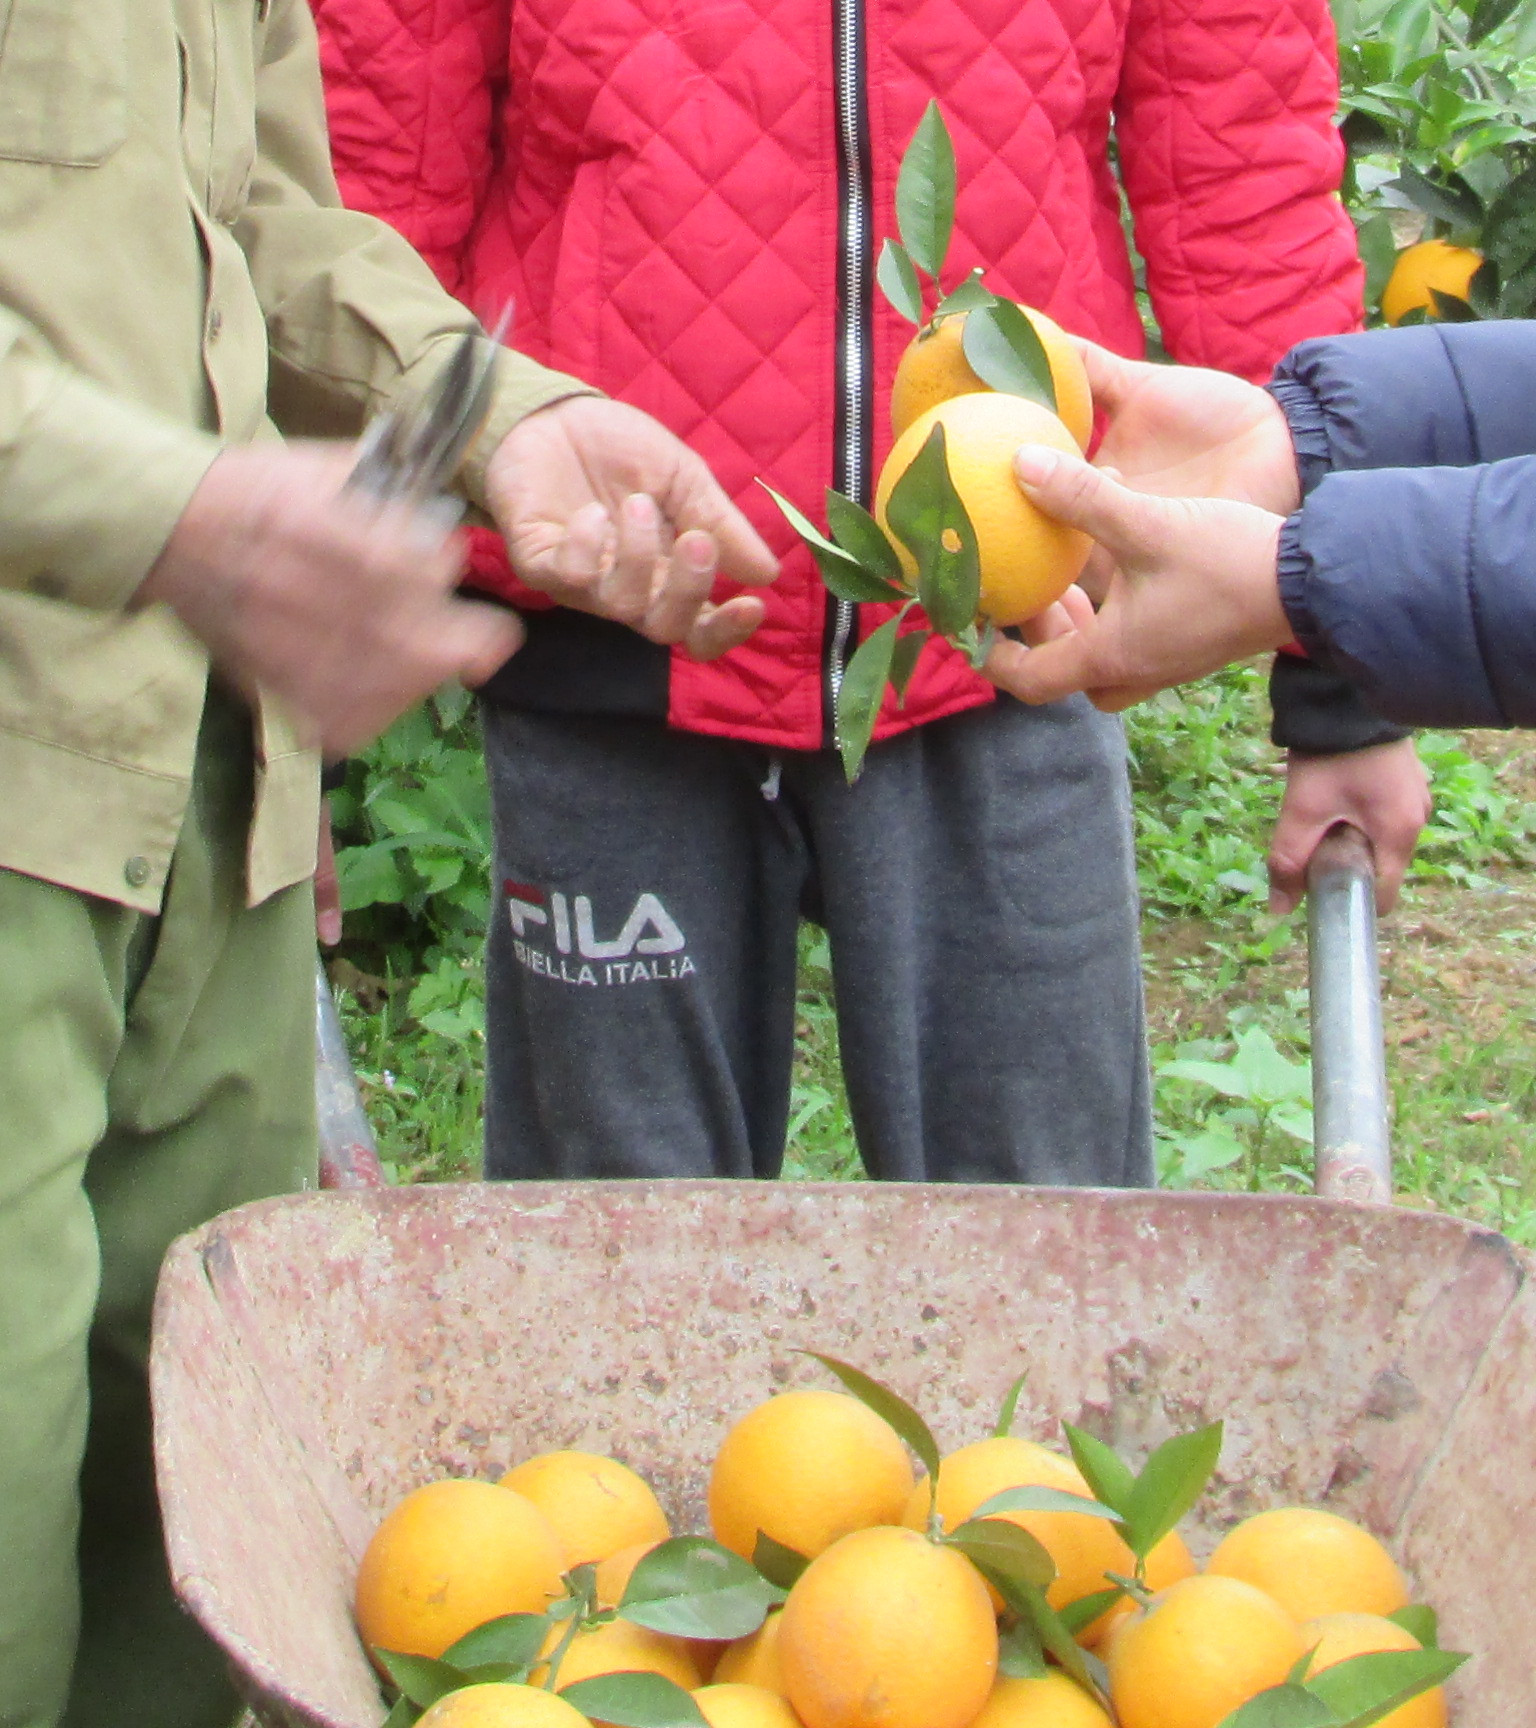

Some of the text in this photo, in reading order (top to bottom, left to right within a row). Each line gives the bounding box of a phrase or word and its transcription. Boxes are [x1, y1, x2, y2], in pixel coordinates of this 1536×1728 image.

[504, 879, 685, 959] FILA
[513, 940, 696, 986] BIELLA ITALIA
